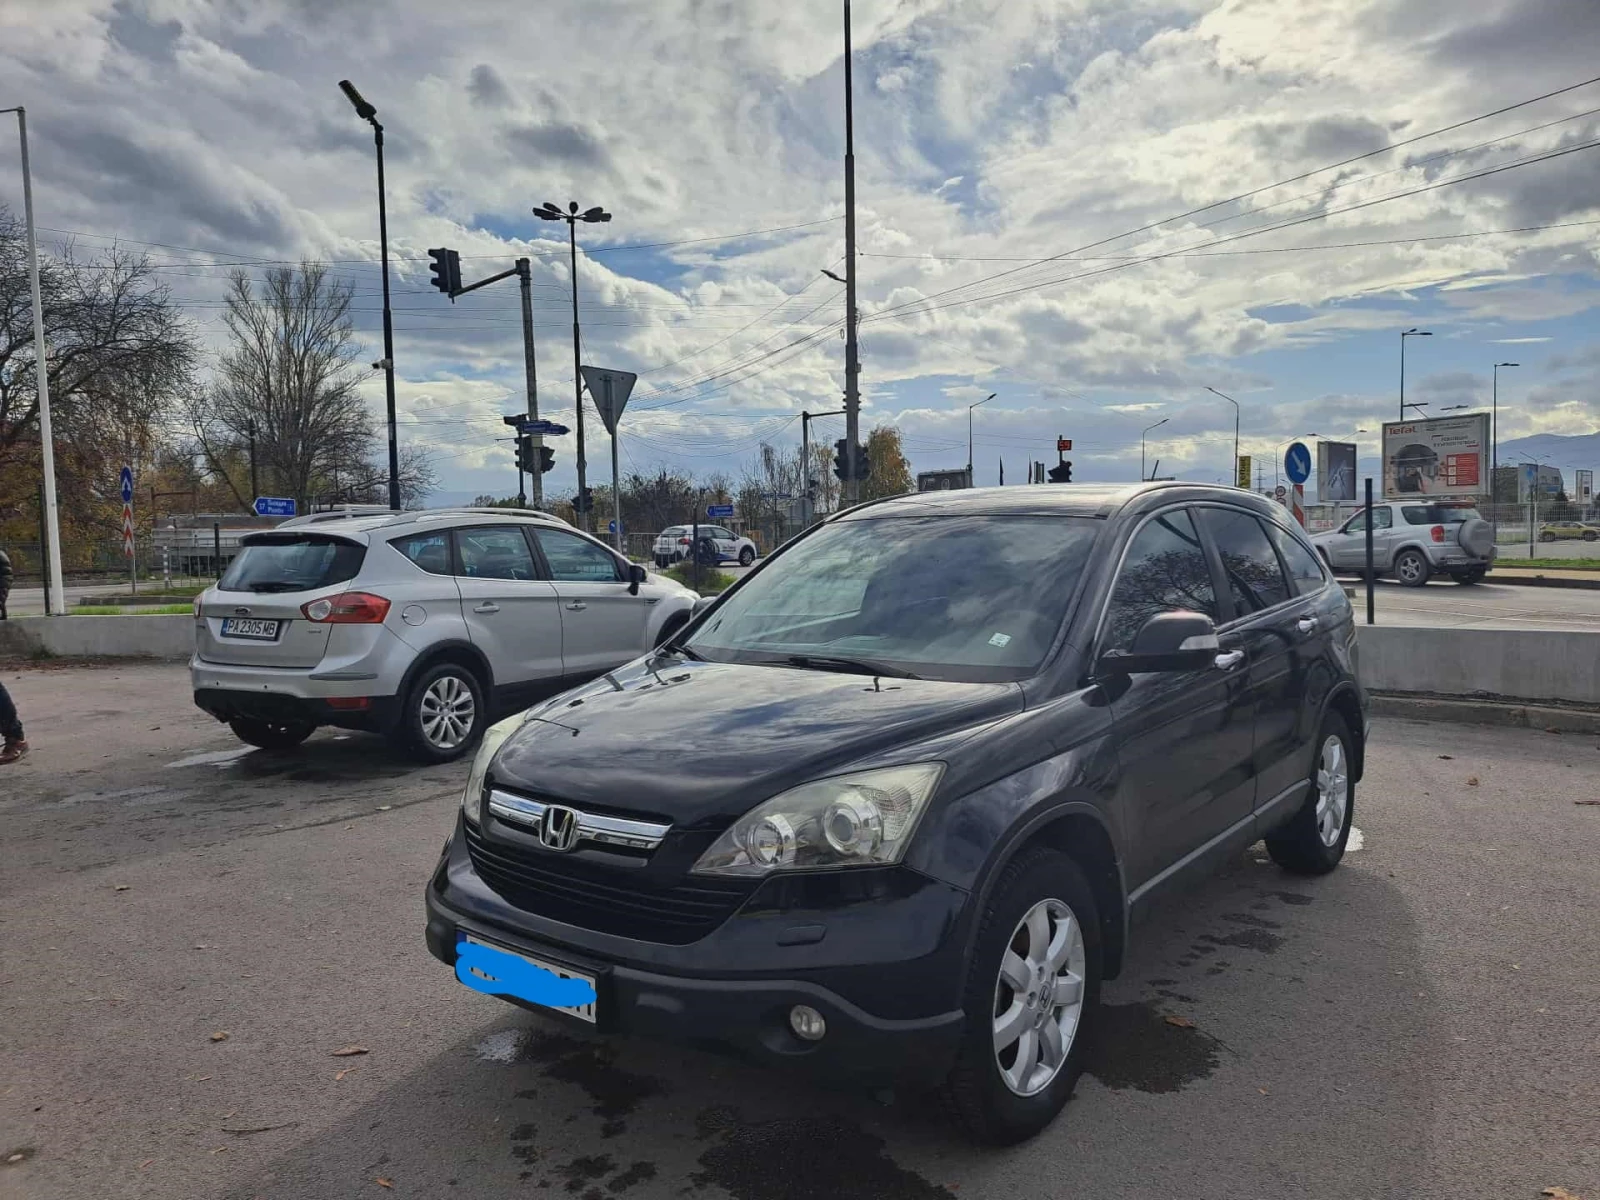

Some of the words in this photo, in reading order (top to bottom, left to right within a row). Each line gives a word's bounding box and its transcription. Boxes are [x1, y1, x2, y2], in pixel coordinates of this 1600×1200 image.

[1388, 424, 1417, 435] Tefal
[227, 619, 239, 632] PA
[240, 620, 263, 634] 2305
[262, 621, 276, 635] MB
